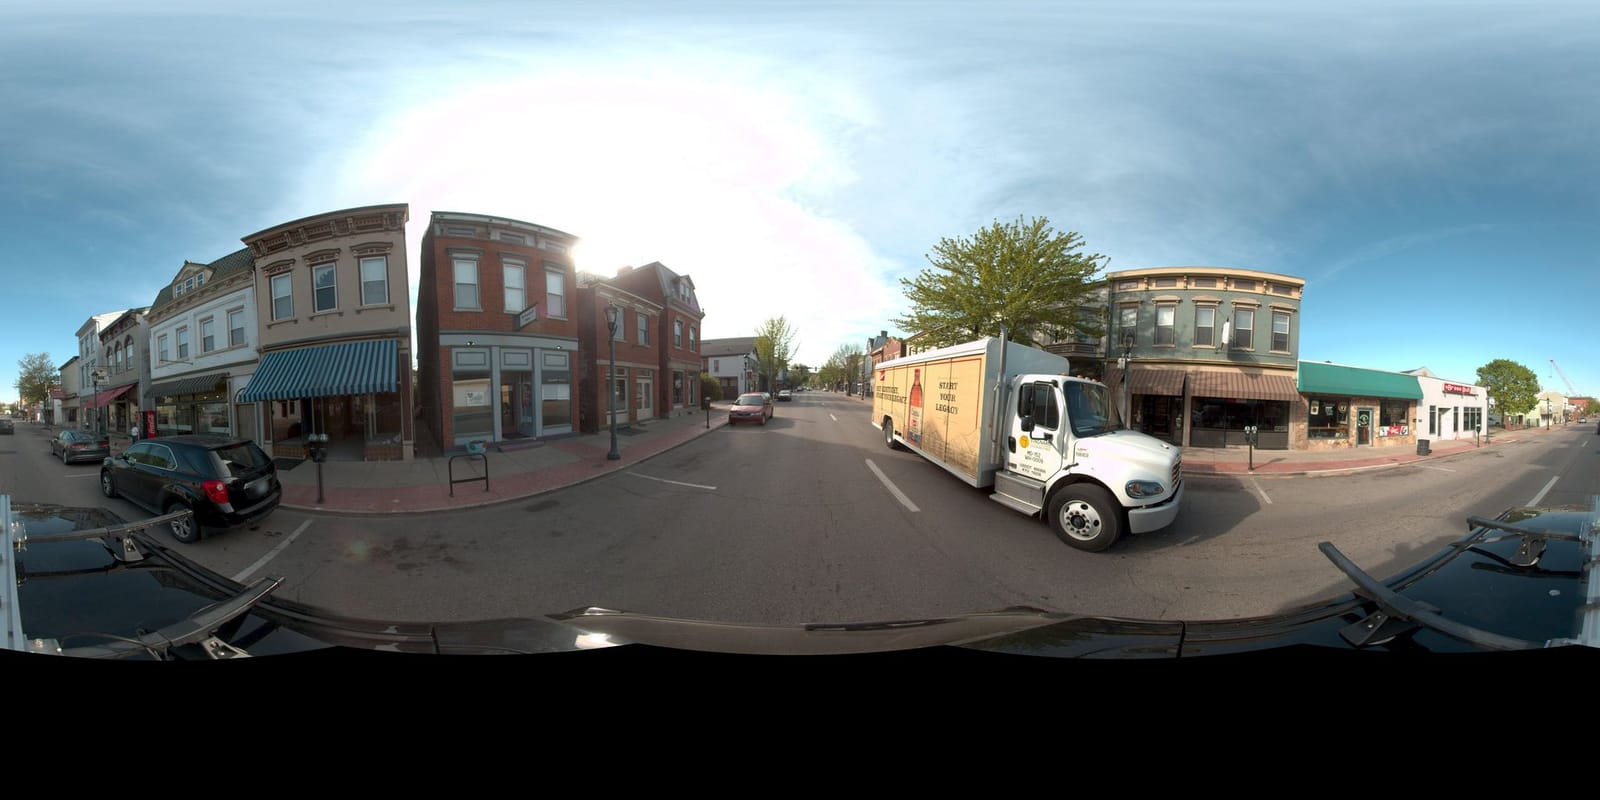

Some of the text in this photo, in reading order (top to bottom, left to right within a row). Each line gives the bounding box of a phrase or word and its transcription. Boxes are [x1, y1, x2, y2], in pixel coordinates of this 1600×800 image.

[939, 382, 958, 390] START
[940, 393, 956, 402] YOUR
[936, 403, 958, 414] LEGACY
